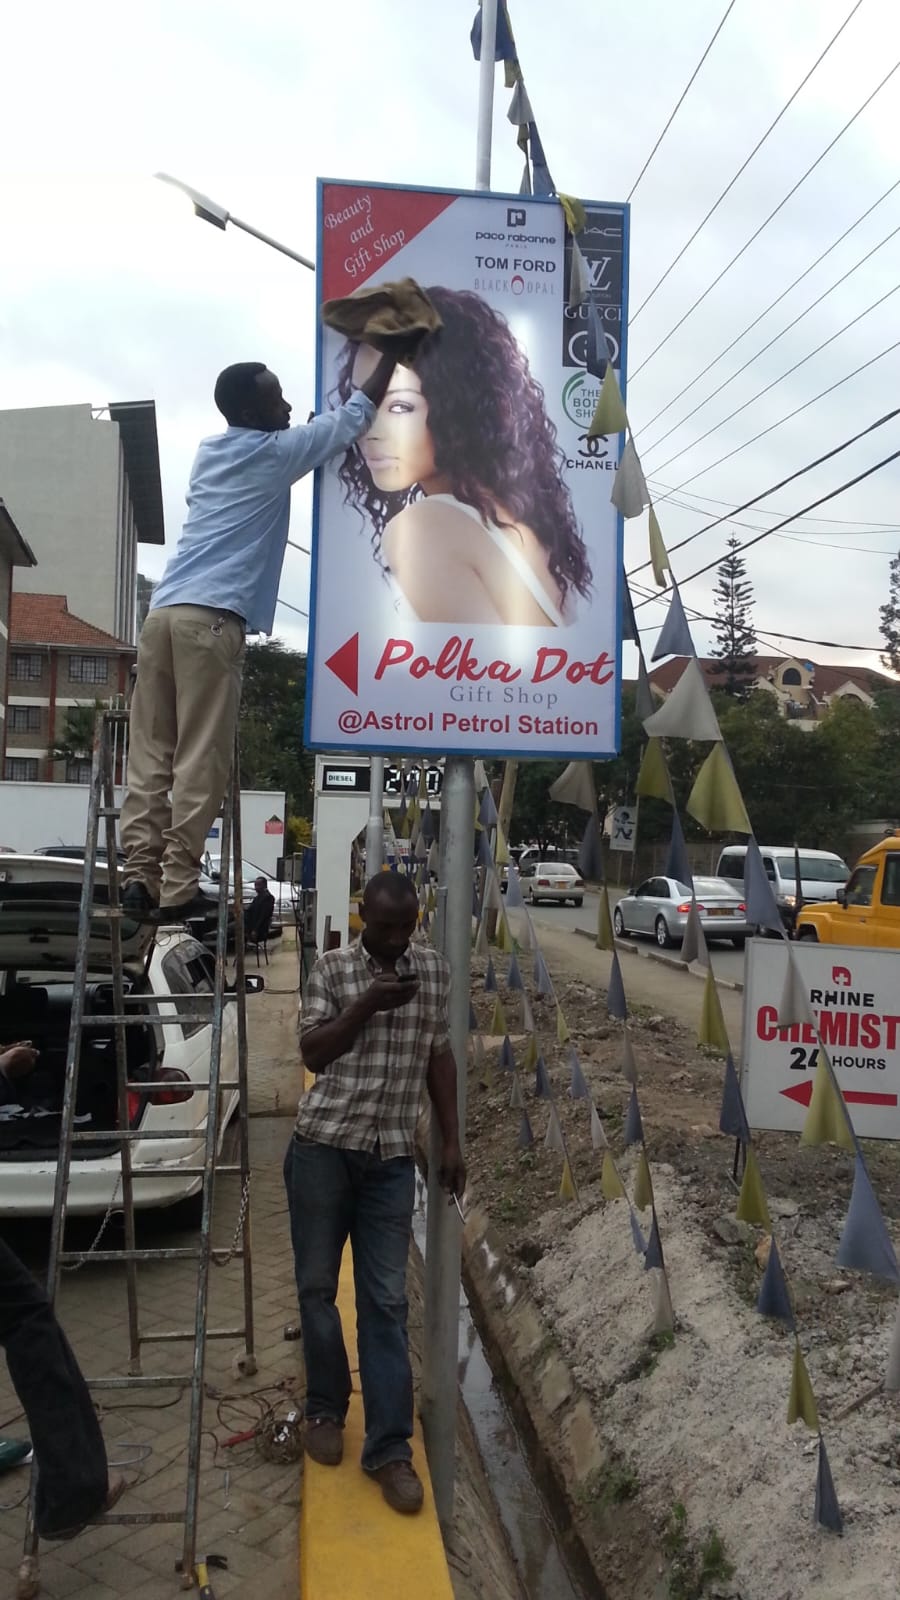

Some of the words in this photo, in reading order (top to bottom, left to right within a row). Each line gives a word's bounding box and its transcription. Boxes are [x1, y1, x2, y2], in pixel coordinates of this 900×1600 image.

[324, 194, 372, 229] Beauty
[350, 213, 374, 244] and
[475, 231, 505, 241] paco
[507, 233, 556, 245] rabanne
[344, 246, 373, 277] Gift
[373, 229, 405, 257] Shop
[474, 255, 509, 271] TOM
[513, 258, 556, 273] FORD
[474, 277, 509, 292] BLACK
[581, 388, 601, 400] THE
[566, 459, 619, 471] CHANEL
[375, 635, 522, 684] Polka
[531, 646, 615, 685] Dot
[450, 685, 492, 703] Gift
[503, 687, 558, 709] Shop
[338, 709, 434, 734] @Astrol
[442, 712, 510, 733] Petrol
[518, 715, 599, 736] Station
[328, 774, 353, 782] DIESEL
[810, 989, 875, 1008] RHINE
[832, 1055, 886, 1070] HOURS
